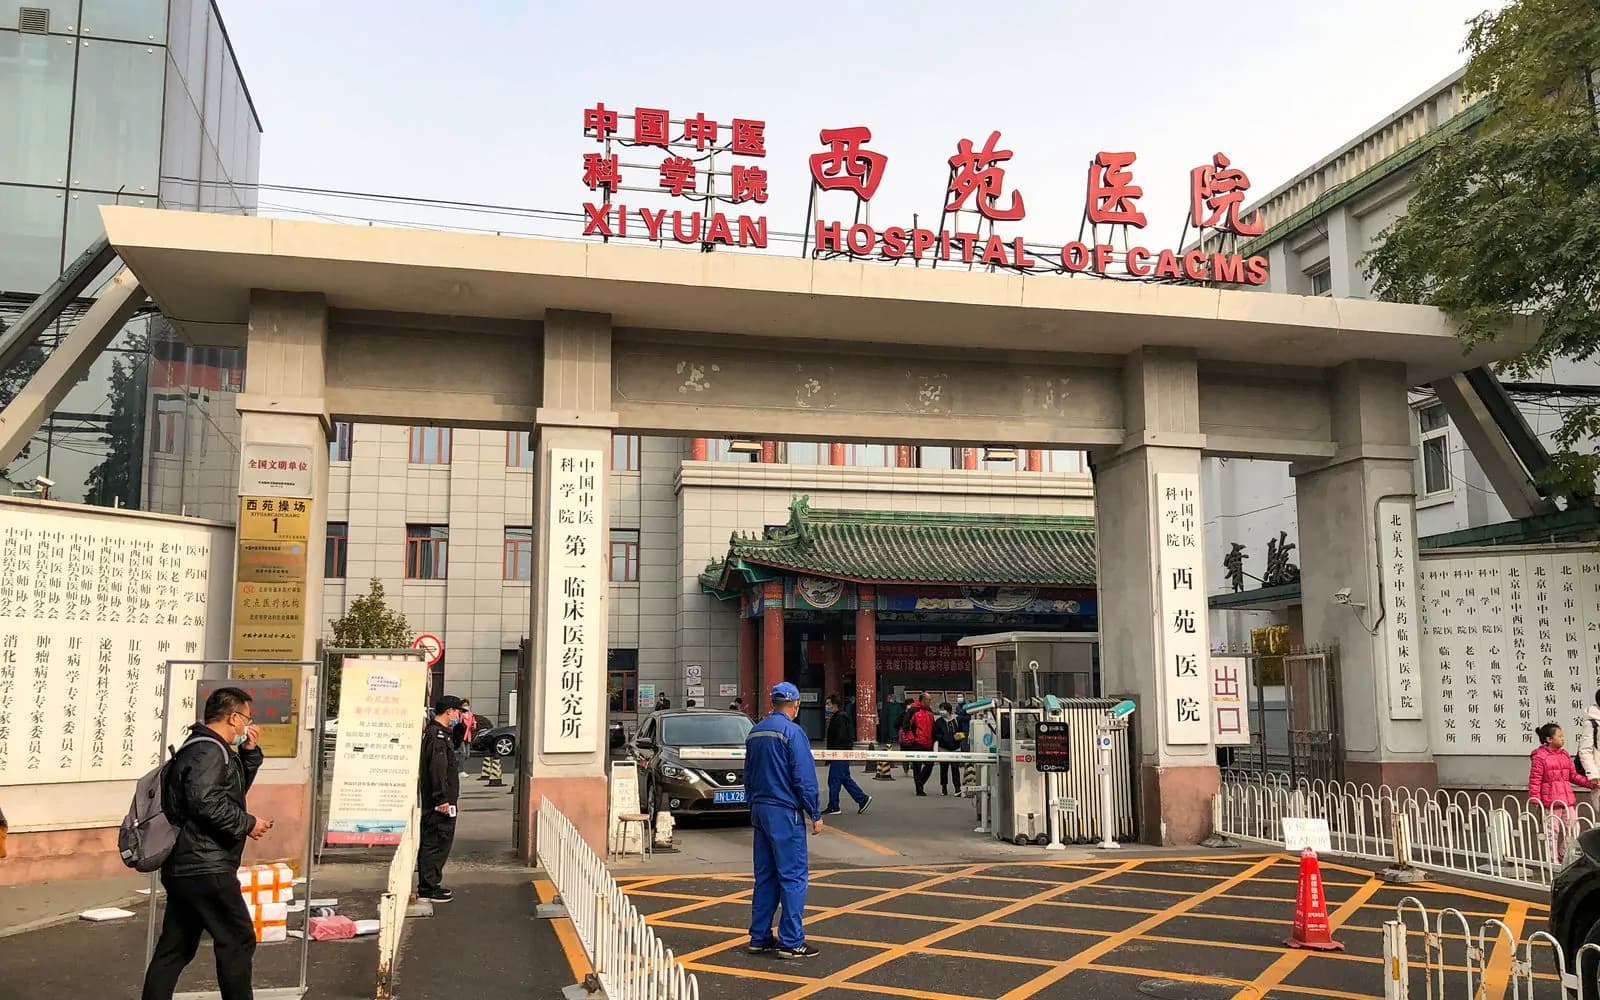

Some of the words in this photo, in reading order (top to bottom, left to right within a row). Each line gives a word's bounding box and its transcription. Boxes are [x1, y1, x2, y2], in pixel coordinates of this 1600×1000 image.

[584, 102, 766, 158] 中国中医
[582, 152, 769, 204] 科学院
[810, 126, 1265, 237] 西苑医院
[815, 219, 1035, 268] HOSPITAL
[1061, 240, 1113, 274] OF
[1126, 246, 1269, 285] CACMS
[248, 459, 308, 472] 全国文明单位
[558, 457, 575, 525] 科学院
[579, 457, 594, 525] 中国中医
[246, 499, 306, 513] 西苑操场
[272, 517, 279, 534] 1
[1165, 487, 1180, 547] 科学院
[1180, 487, 1195, 547] 中国中医
[560, 534, 587, 739] 第一临床医药研究所
[1171, 566, 1201, 722] 西苑医院
[1390, 514, 1414, 709] 北京大学中医药临床医学院
[1534, 566, 1558, 724] 北京市中西医结合血液病研
[1214, 665, 1242, 735] 出口
